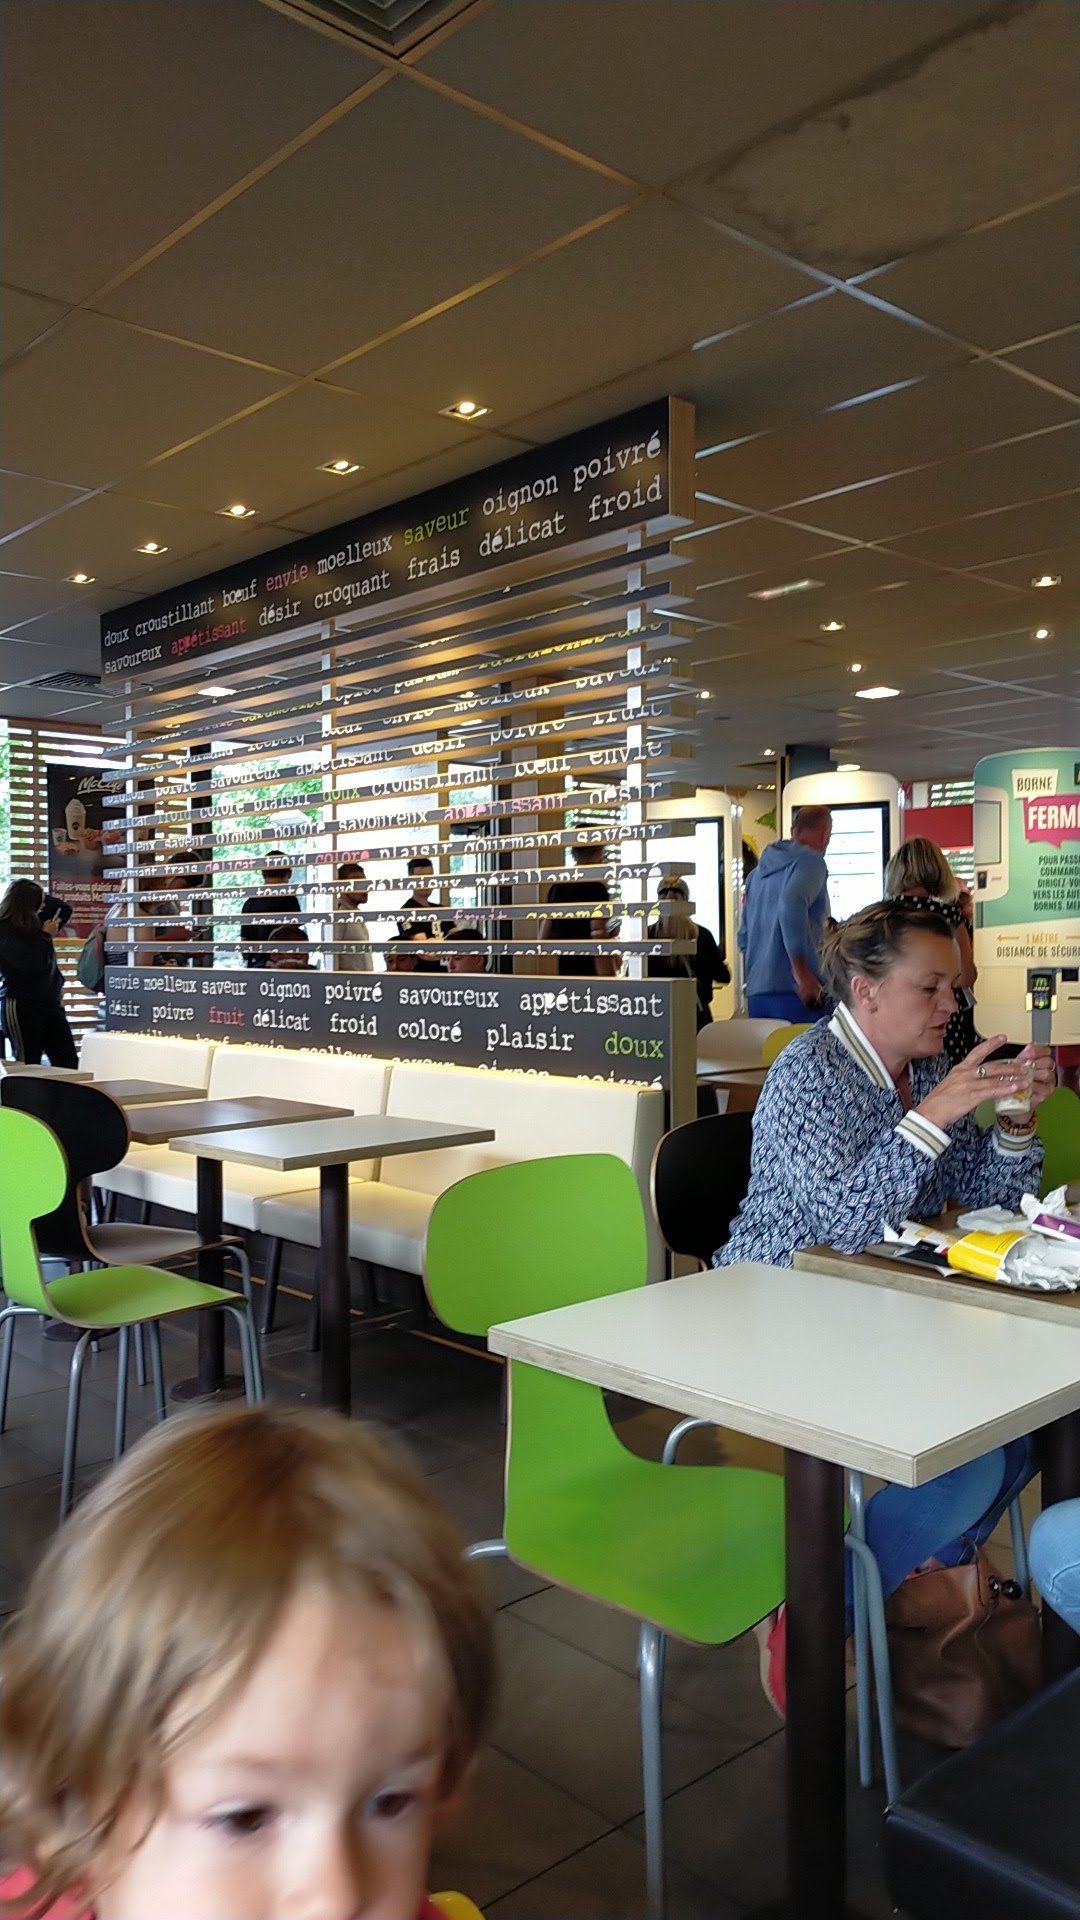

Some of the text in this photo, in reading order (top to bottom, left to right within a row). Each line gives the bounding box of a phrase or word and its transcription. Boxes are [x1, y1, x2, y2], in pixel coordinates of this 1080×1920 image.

[104, 430, 662, 648] doux croustillant bœuf envie moelleux saveur oignon poivré
[104, 474, 663, 674] savoureux appétissant désir croquant frais délicat froid
[1017, 776, 1053, 792] BORNE
[1038, 855, 1058, 865] POUR
[1033, 890, 1051, 900] VERS
[1053, 890, 1065, 899] LES
[997, 946, 1035, 957] DISTANCE
[1038, 946, 1048, 957] DE
[108, 974, 664, 1018] envie moelleux saveur oignon poivré savoureux appétissant
[108, 1000, 665, 1059] désir poivre fruit délicat froid coloré plaisir doux
